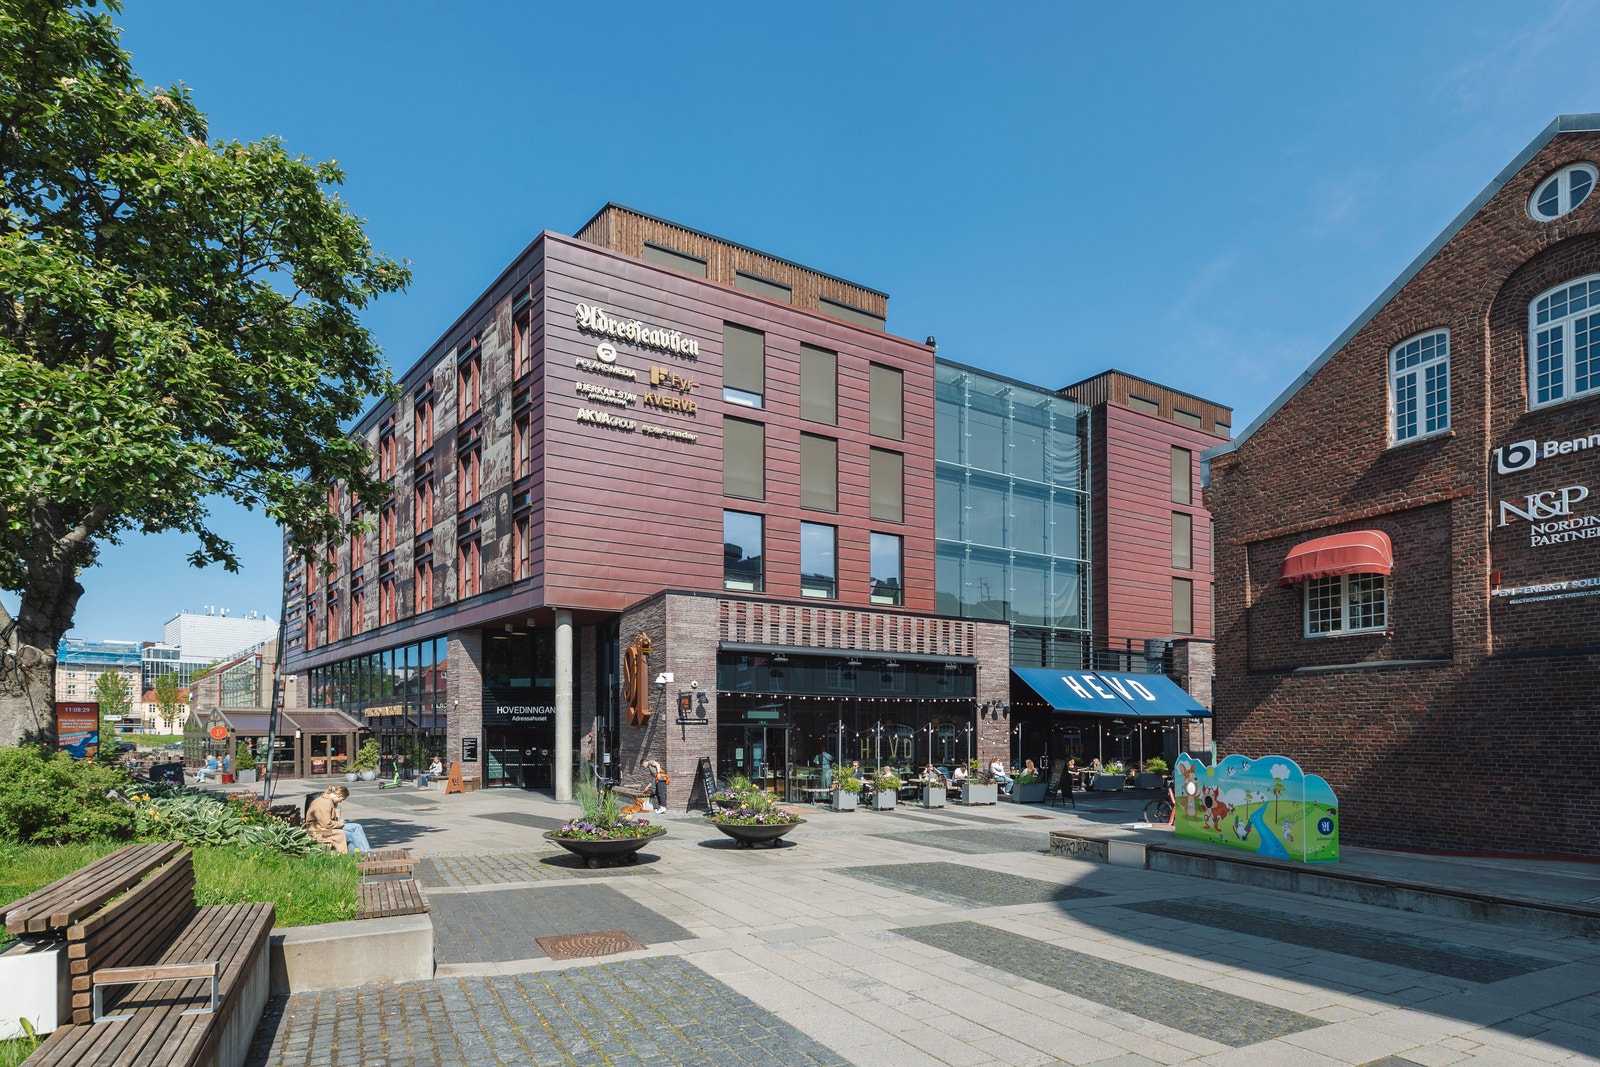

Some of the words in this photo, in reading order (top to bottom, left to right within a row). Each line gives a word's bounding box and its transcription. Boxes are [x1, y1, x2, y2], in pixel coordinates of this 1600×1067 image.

[644, 391, 698, 412] KVERVA
[1543, 434, 1600, 458] Benn
[1497, 486, 1589, 527] N&P
[1530, 528, 1600, 547] PARTNE
[1524, 582, 1568, 594] ENERGY
[1061, 675, 1156, 701] HEVD
[496, 705, 556, 714] HOVEDINNGAN
[860, 735, 913, 759] HEVD
